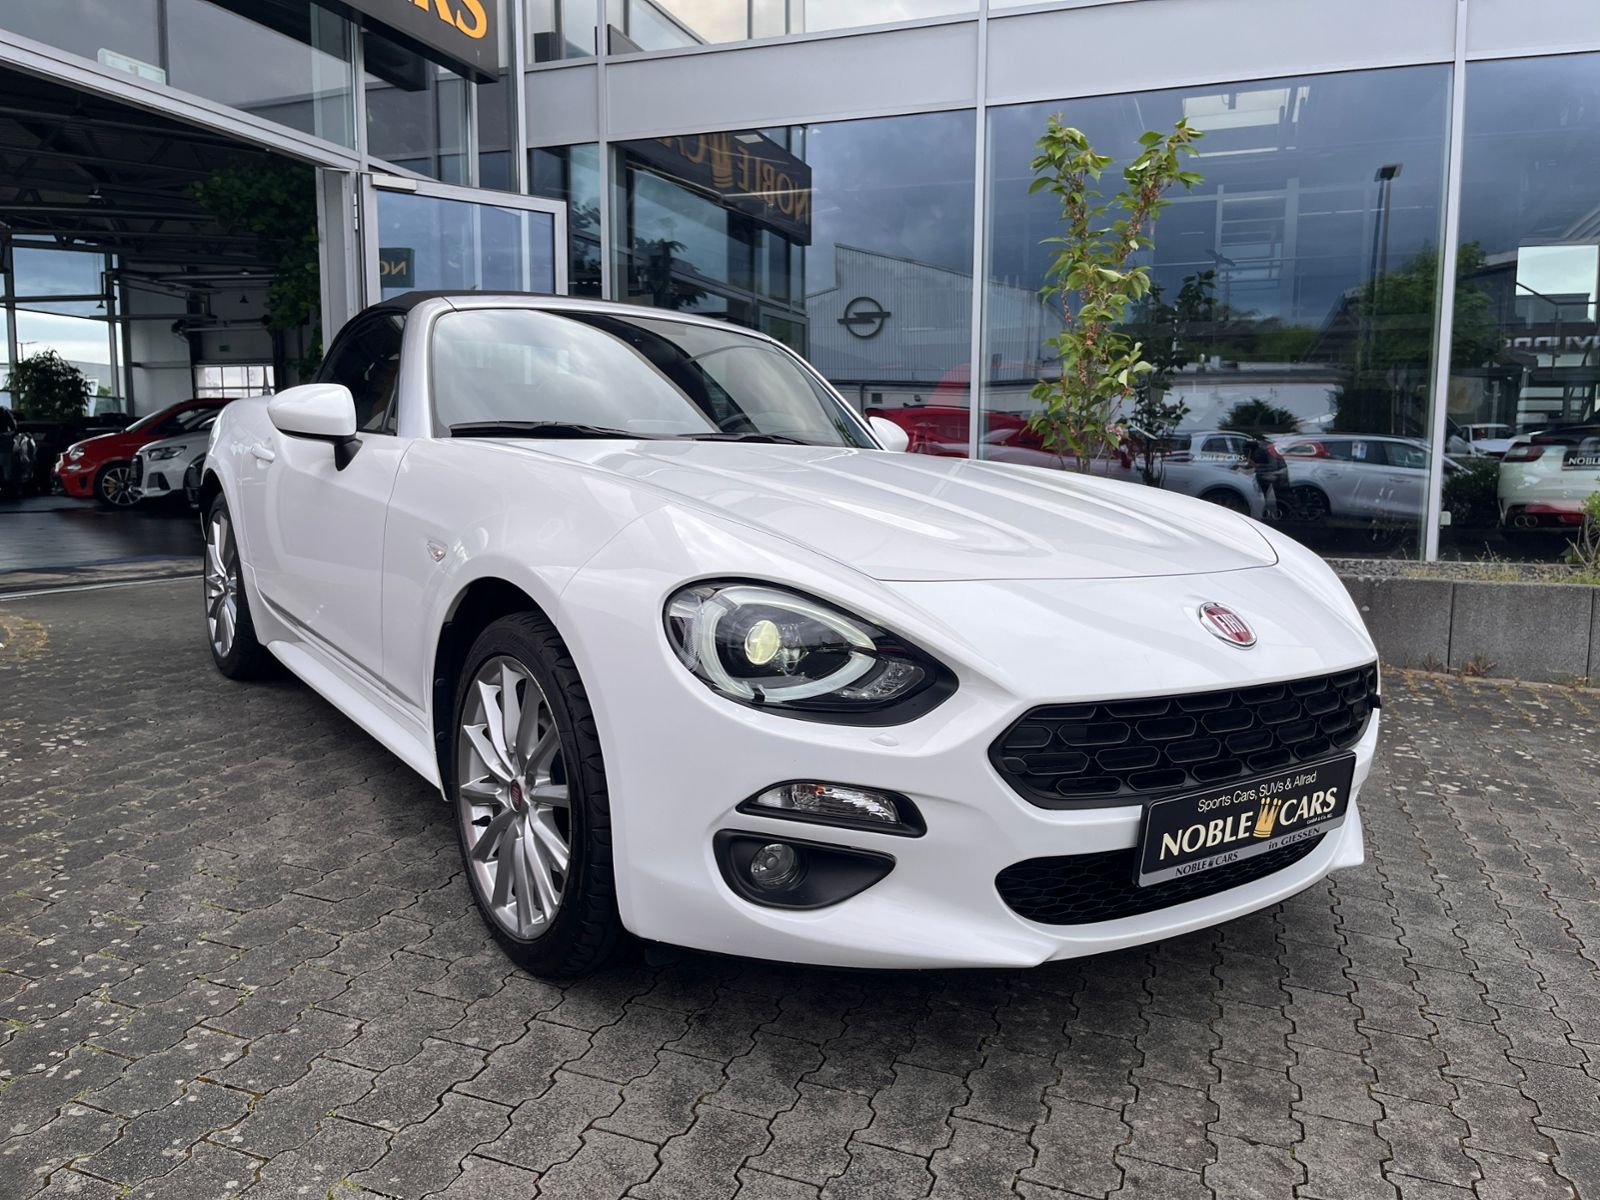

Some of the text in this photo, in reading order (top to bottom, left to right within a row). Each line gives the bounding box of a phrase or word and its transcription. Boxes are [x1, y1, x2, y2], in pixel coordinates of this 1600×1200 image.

[1197, 771, 1317, 813] Sports Cars, SUVs & Allrad
[1160, 787, 1337, 861] NOBLE CARS
[1175, 827, 1320, 876] NOBLE CARS in GIESSEN
